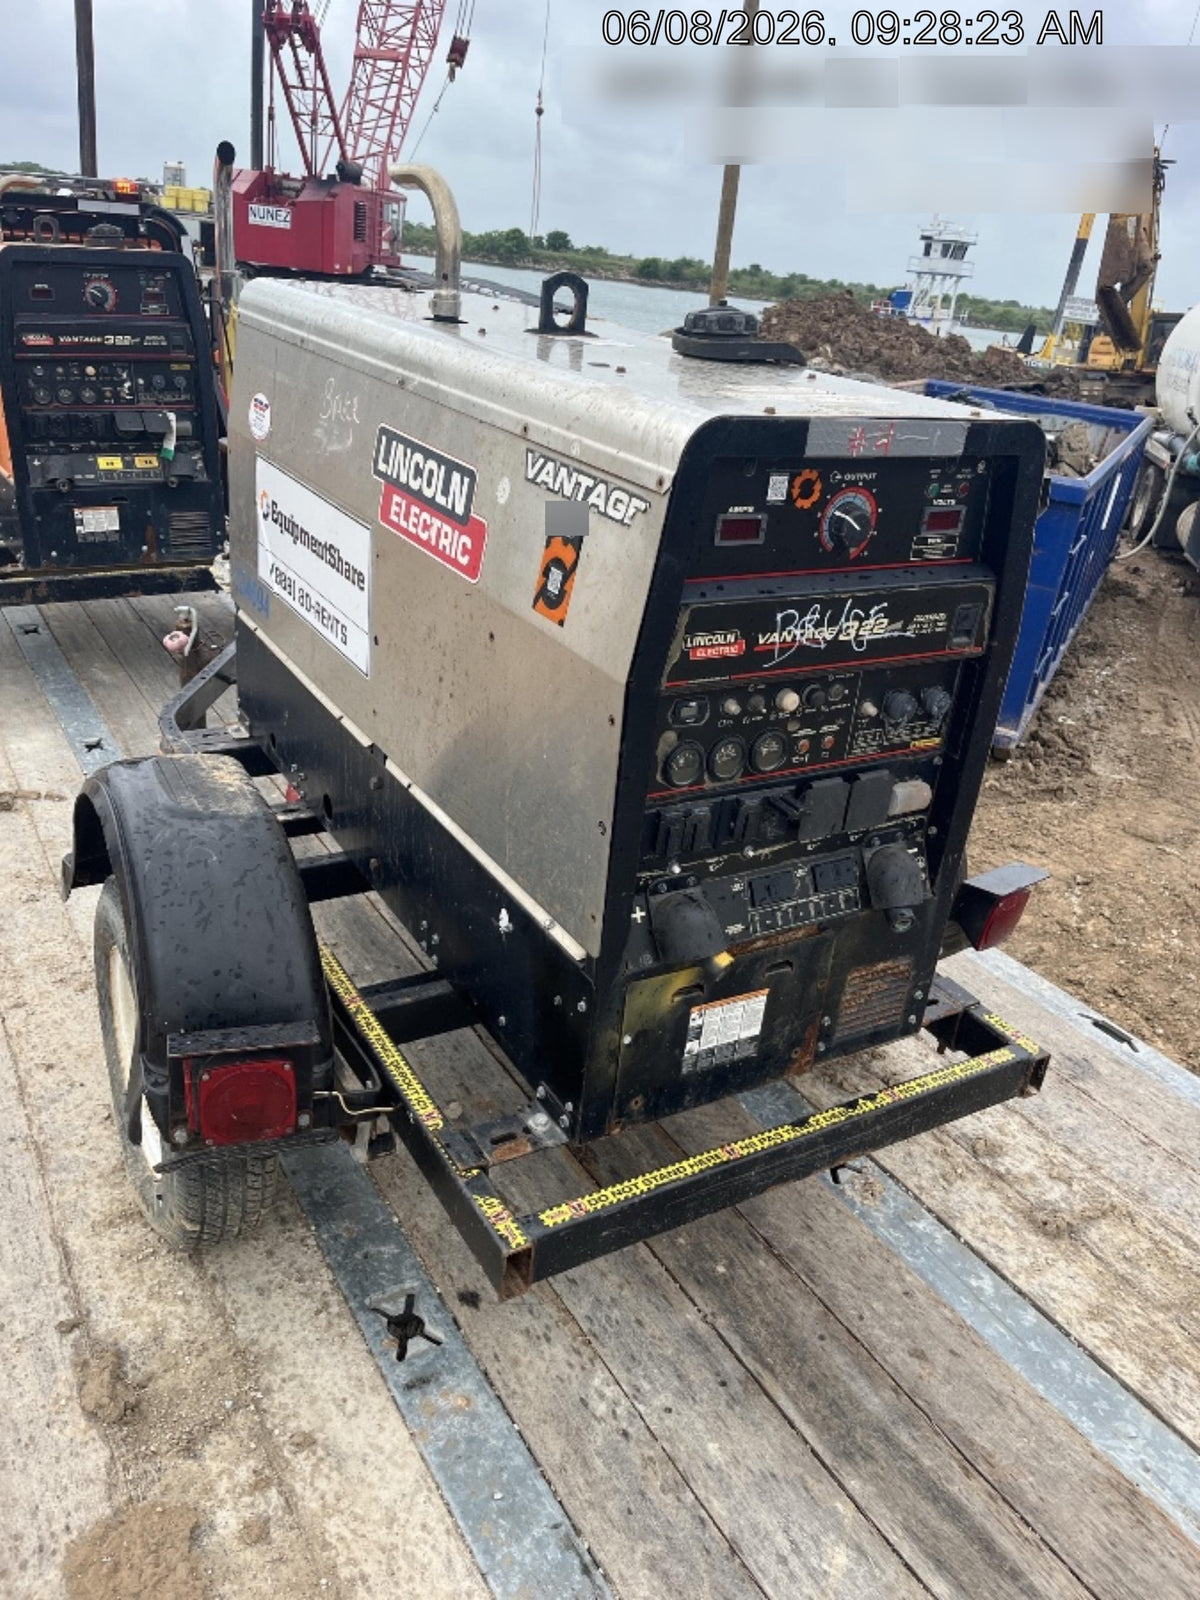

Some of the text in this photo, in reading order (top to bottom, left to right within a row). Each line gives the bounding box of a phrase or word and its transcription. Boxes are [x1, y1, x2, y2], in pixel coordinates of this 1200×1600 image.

[377, 435, 470, 517] LINCOLN
[271, 500, 366, 591] EquipmentShare
[389, 494, 473, 567] ELECTRIC
[685, 633, 737, 648] LINCOLN
[695, 645, 740, 658] ELECTRIC
[586, 1150, 723, 1207] DO NOT STAND HERE
